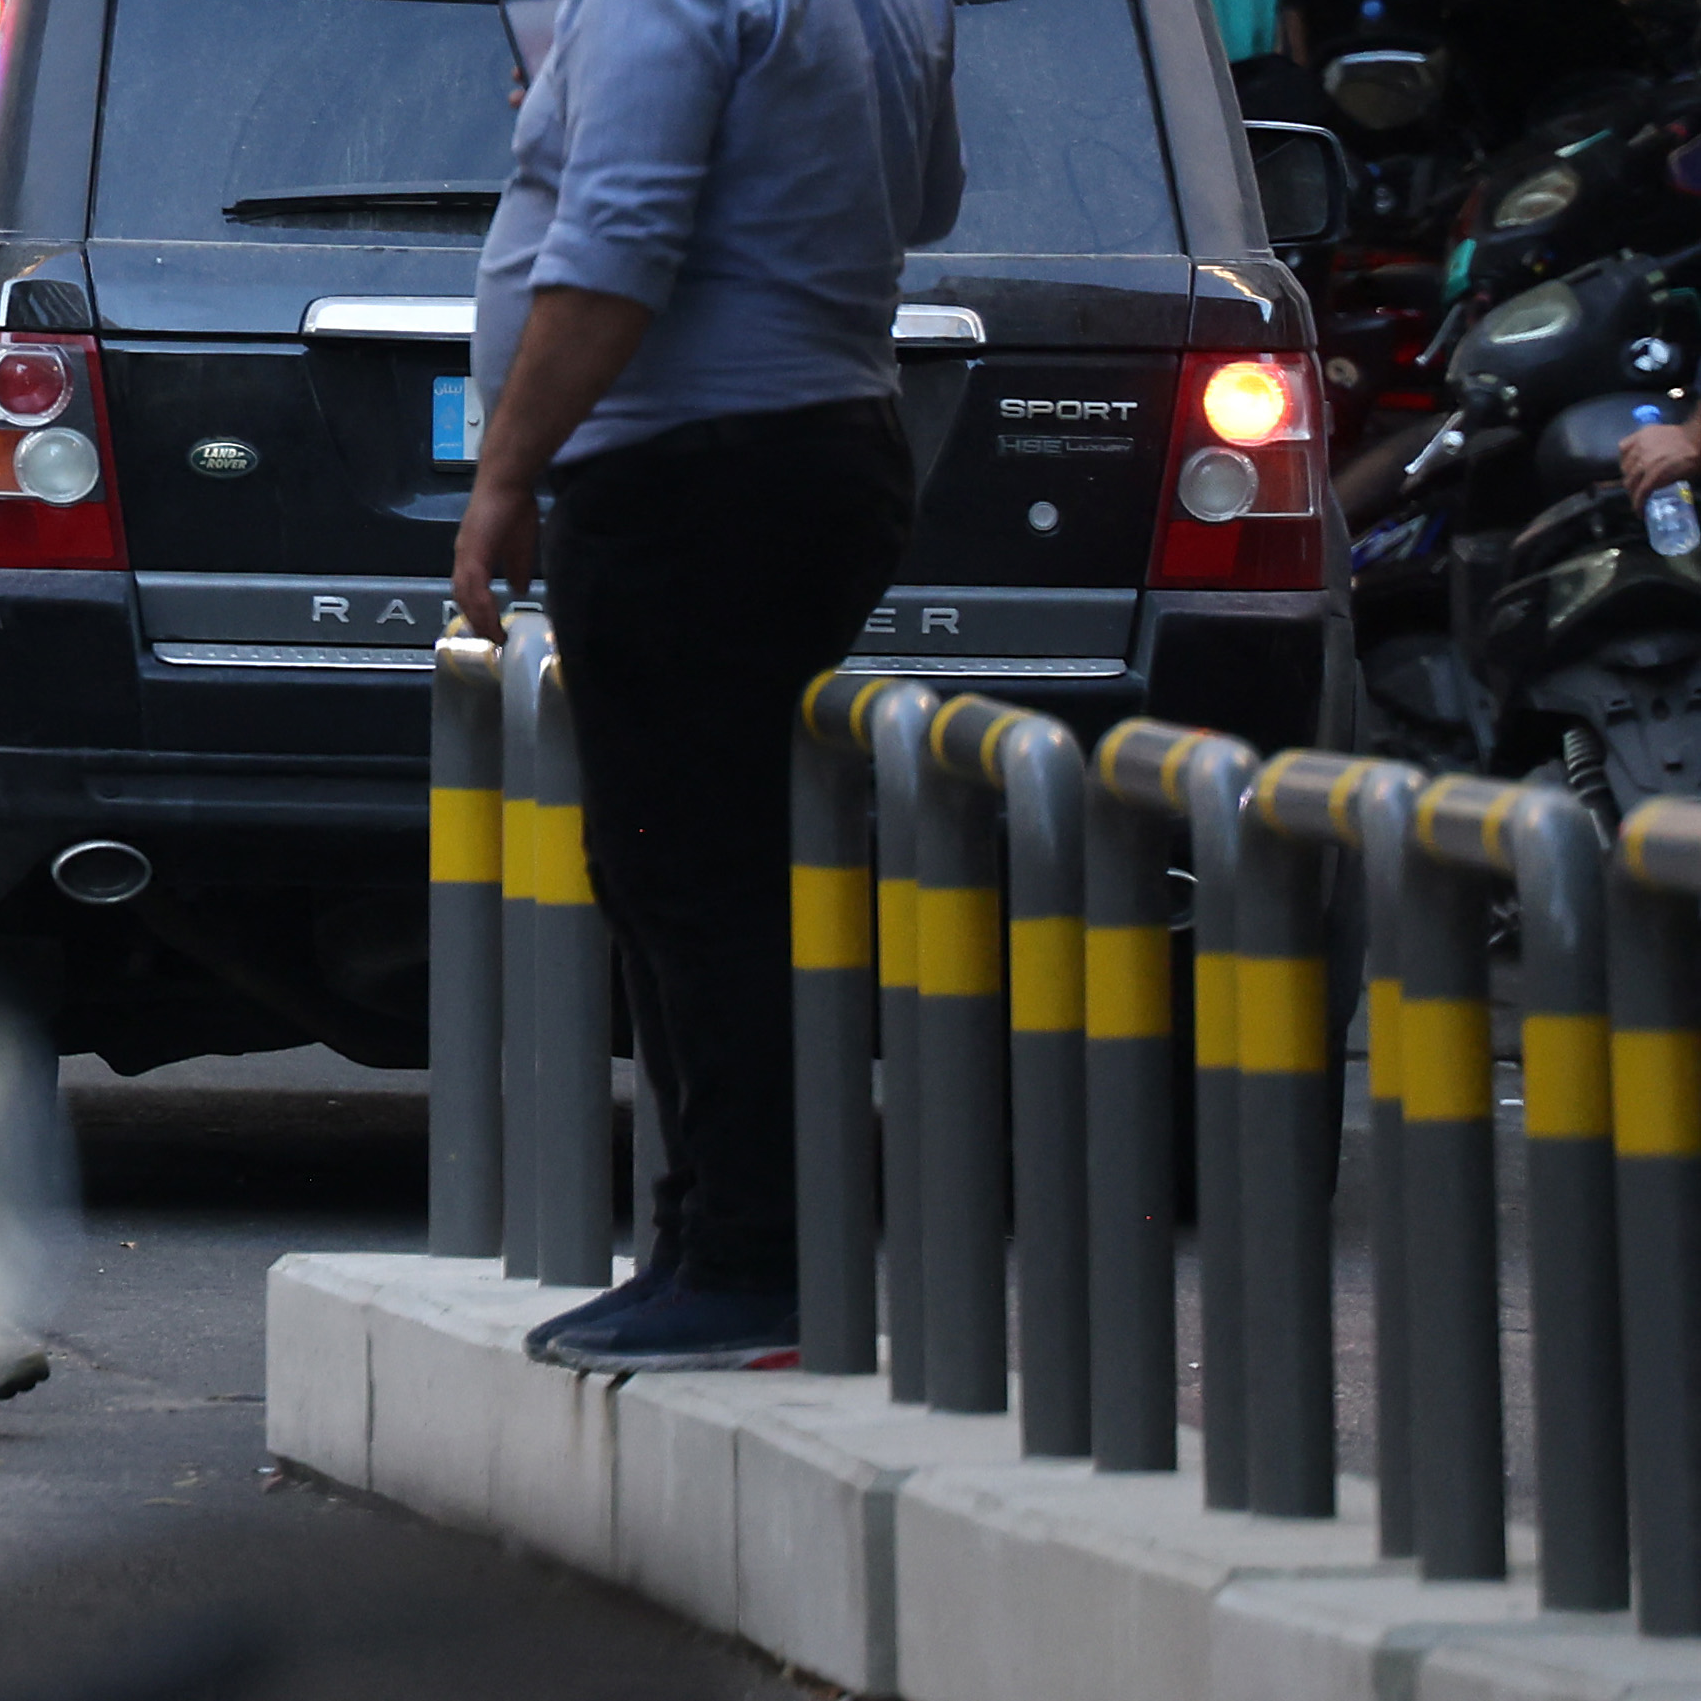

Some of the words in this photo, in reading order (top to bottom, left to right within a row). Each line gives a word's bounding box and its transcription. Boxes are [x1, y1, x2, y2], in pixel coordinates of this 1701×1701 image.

[1000, 398, 1138, 421] SPORT
[204, 447, 237, 458] LAND
[1001, 437, 1062, 454] HSE
[207, 458, 248, 469] ROVER
